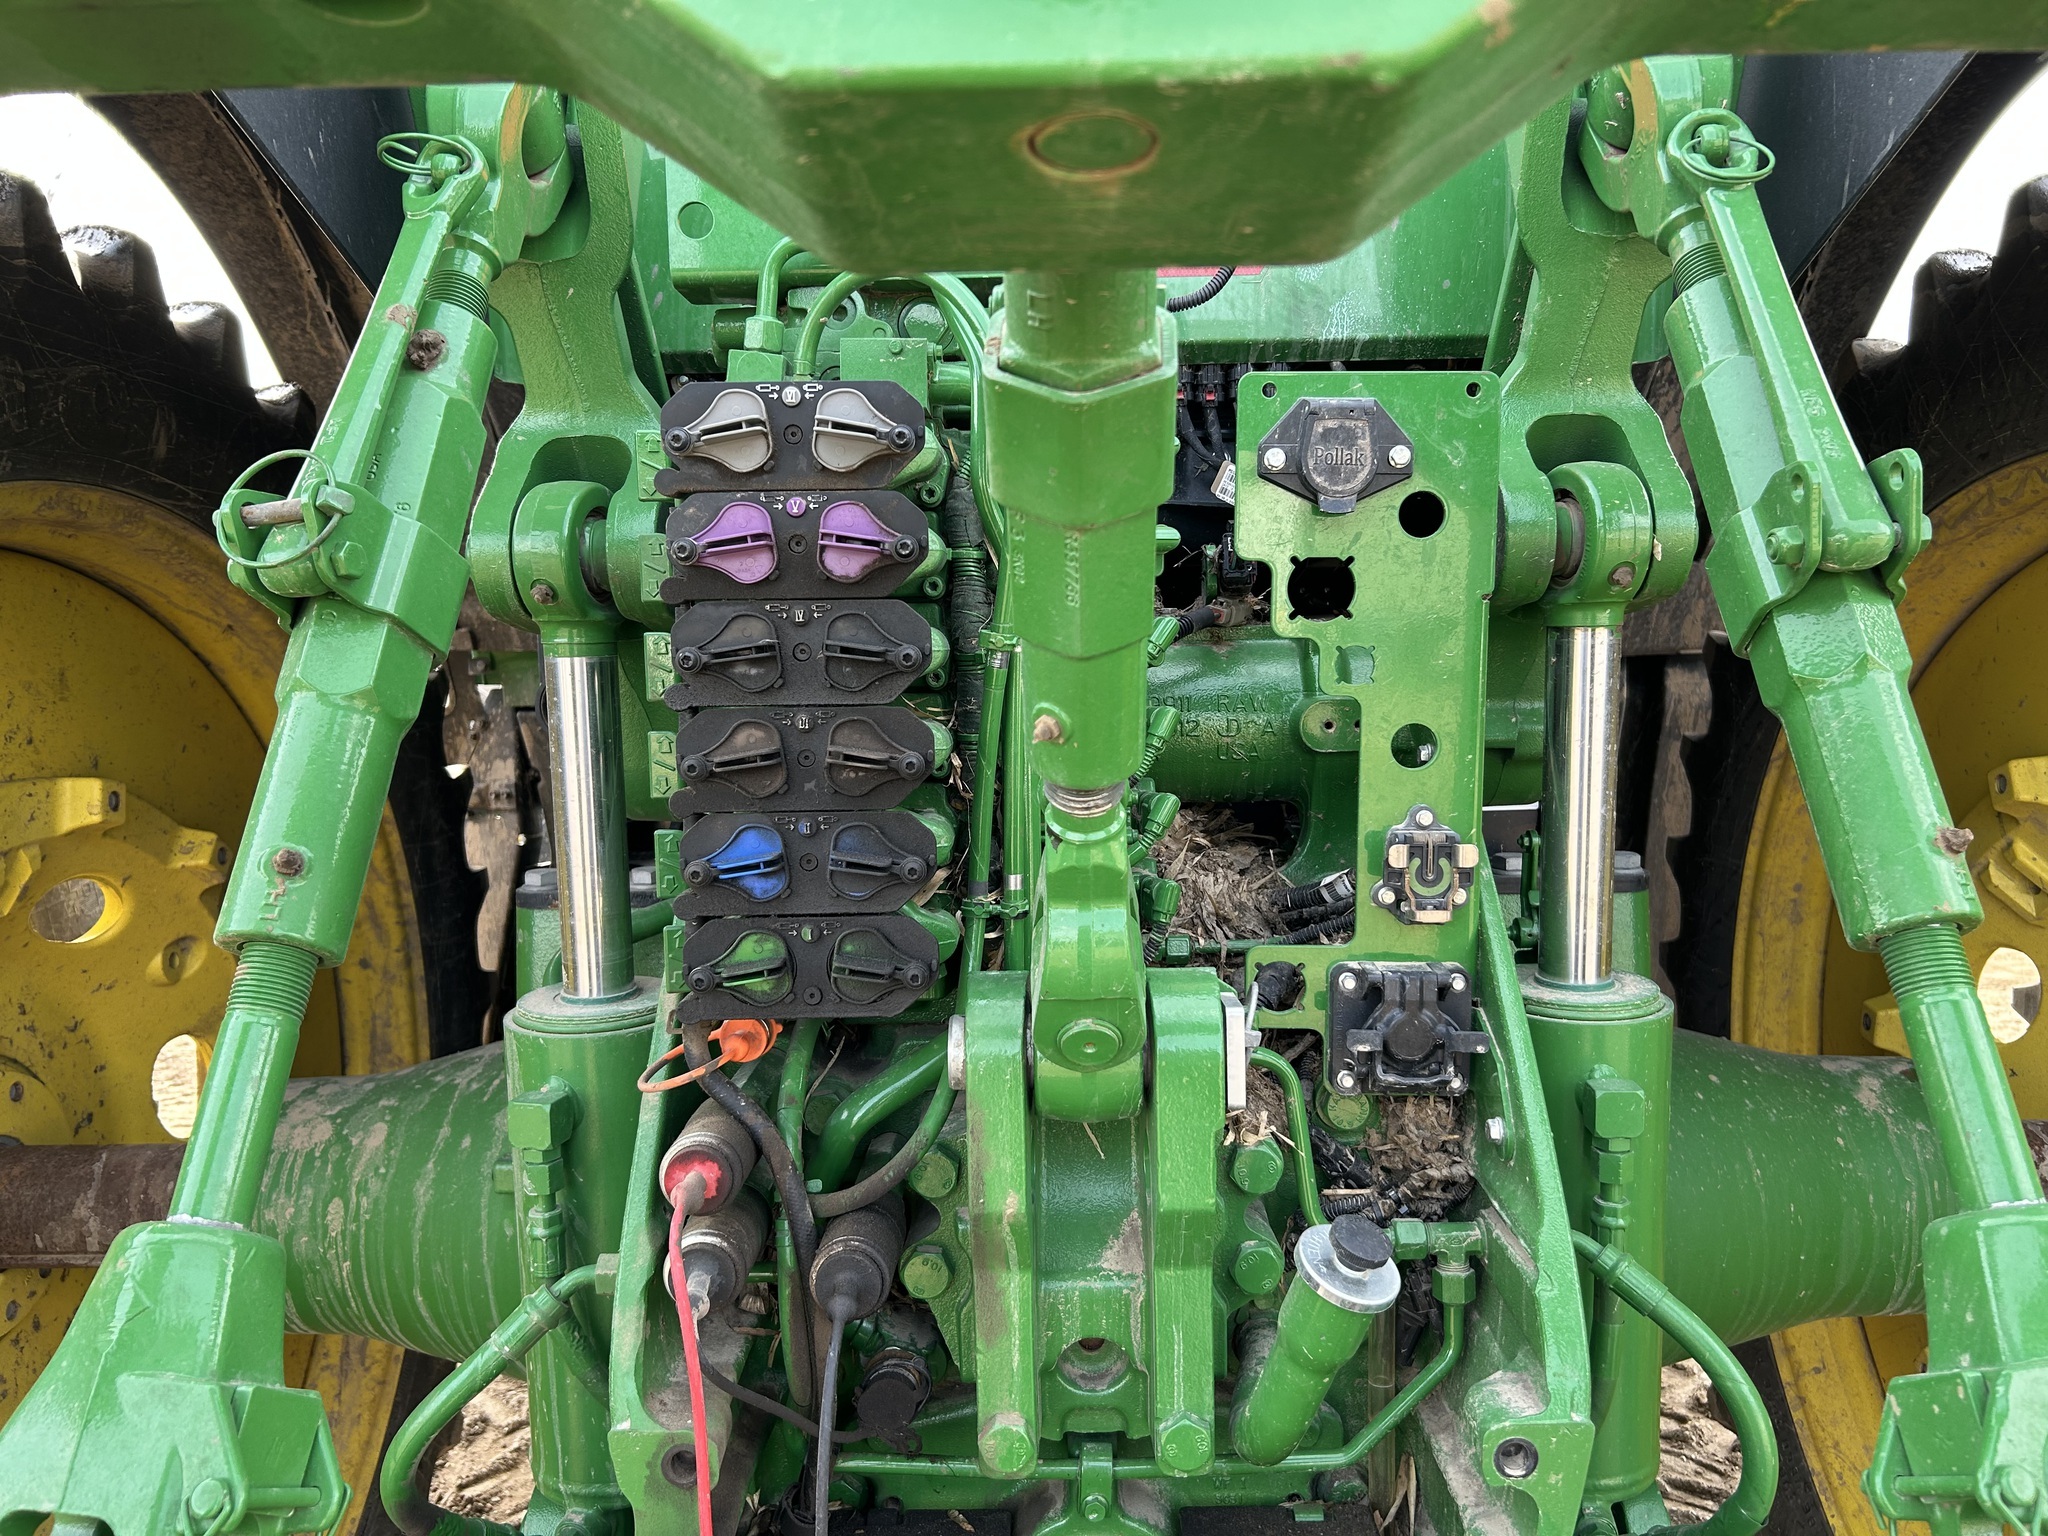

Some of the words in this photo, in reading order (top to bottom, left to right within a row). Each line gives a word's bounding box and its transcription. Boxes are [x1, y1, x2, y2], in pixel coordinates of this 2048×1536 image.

[1312, 446, 1366, 468] Pollak
[1216, 694, 1270, 713] RAW
[1216, 742, 1260, 761] USA
